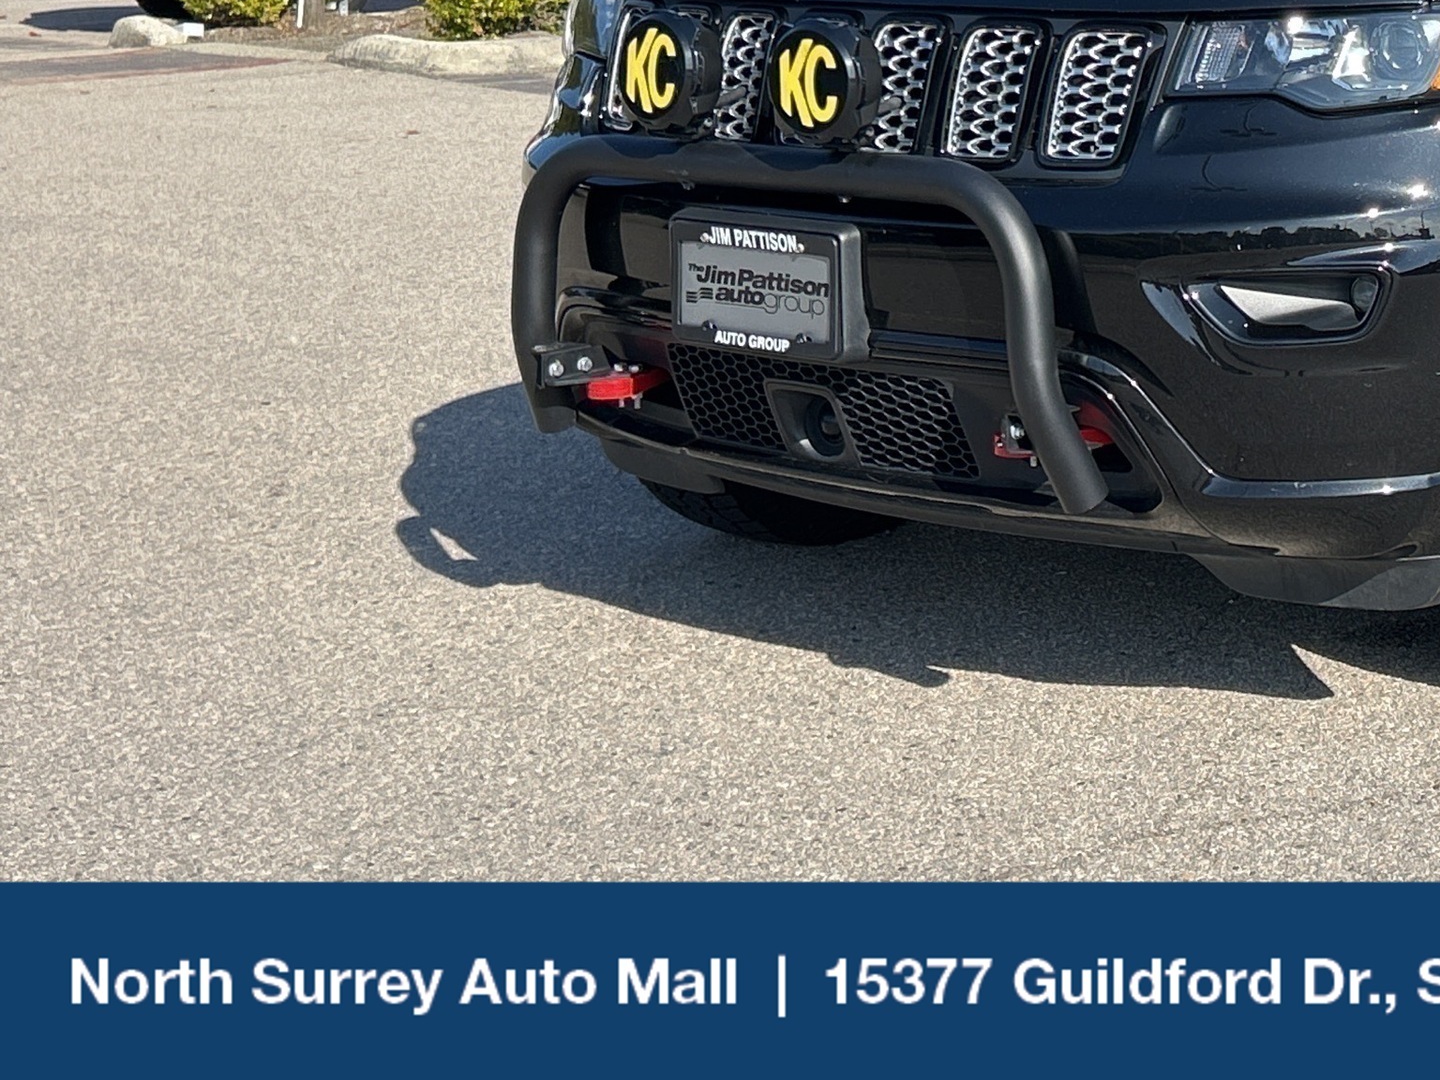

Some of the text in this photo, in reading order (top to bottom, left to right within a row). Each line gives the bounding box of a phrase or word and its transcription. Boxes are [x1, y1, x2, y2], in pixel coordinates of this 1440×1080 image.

[625, 27, 677, 114] KC
[779, 38, 838, 128] KC
[708, 226, 798, 253] JIM PATTISON
[737, 268, 830, 298] Pattison
[714, 330, 790, 353] AUTO GROUP
